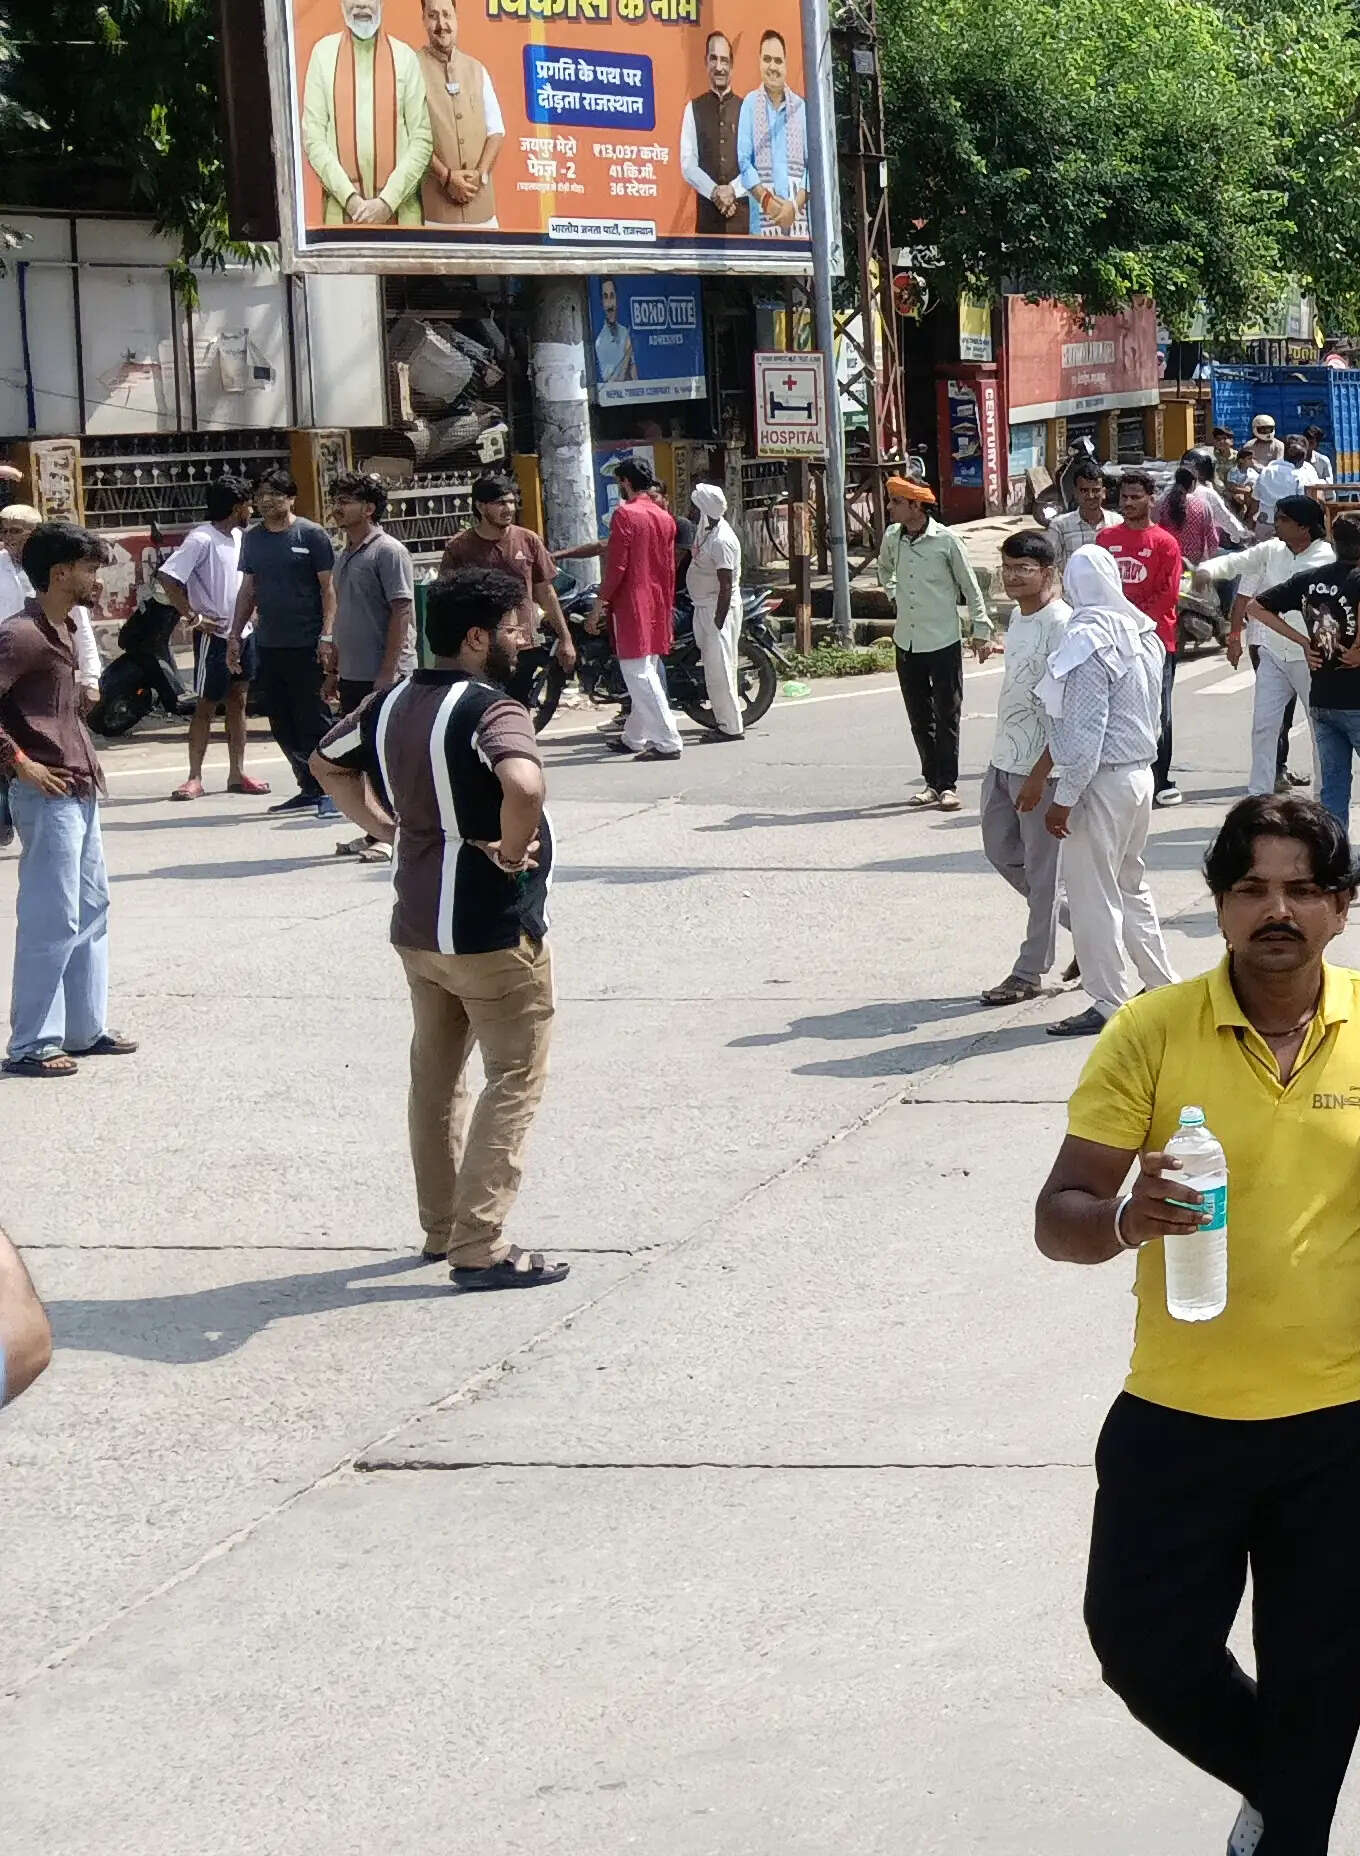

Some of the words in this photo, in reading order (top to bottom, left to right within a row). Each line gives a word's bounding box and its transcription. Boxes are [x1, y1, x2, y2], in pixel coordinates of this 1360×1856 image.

[536, 58, 576, 81] प्रगति
[578, 59, 594, 82] के
[597, 66, 620, 86] पथ
[623, 69, 642, 87] पर
[537, 82, 580, 114] दौड़ता
[583, 92, 643, 115] राजस्थान
[519, 137, 554, 159] जयपुर
[556, 135, 577, 157] मेट्रो
[639, 143, 669, 165] करोड़
[609, 163, 622, 178] 41
[610, 182, 624, 196] 36
[626, 180, 657, 197] स्टेशन
[552, 221, 579, 234] भारतीय
[581, 225, 602, 235] जनता
[623, 226, 654, 236] राजस्थान
[633, 302, 665, 324] BOND
[669, 302, 696, 323] TITE
[760, 430, 824, 445] HOSPITAL
[985, 388, 998, 473] CENTURY
[1308, 582, 1338, 596] POLO
